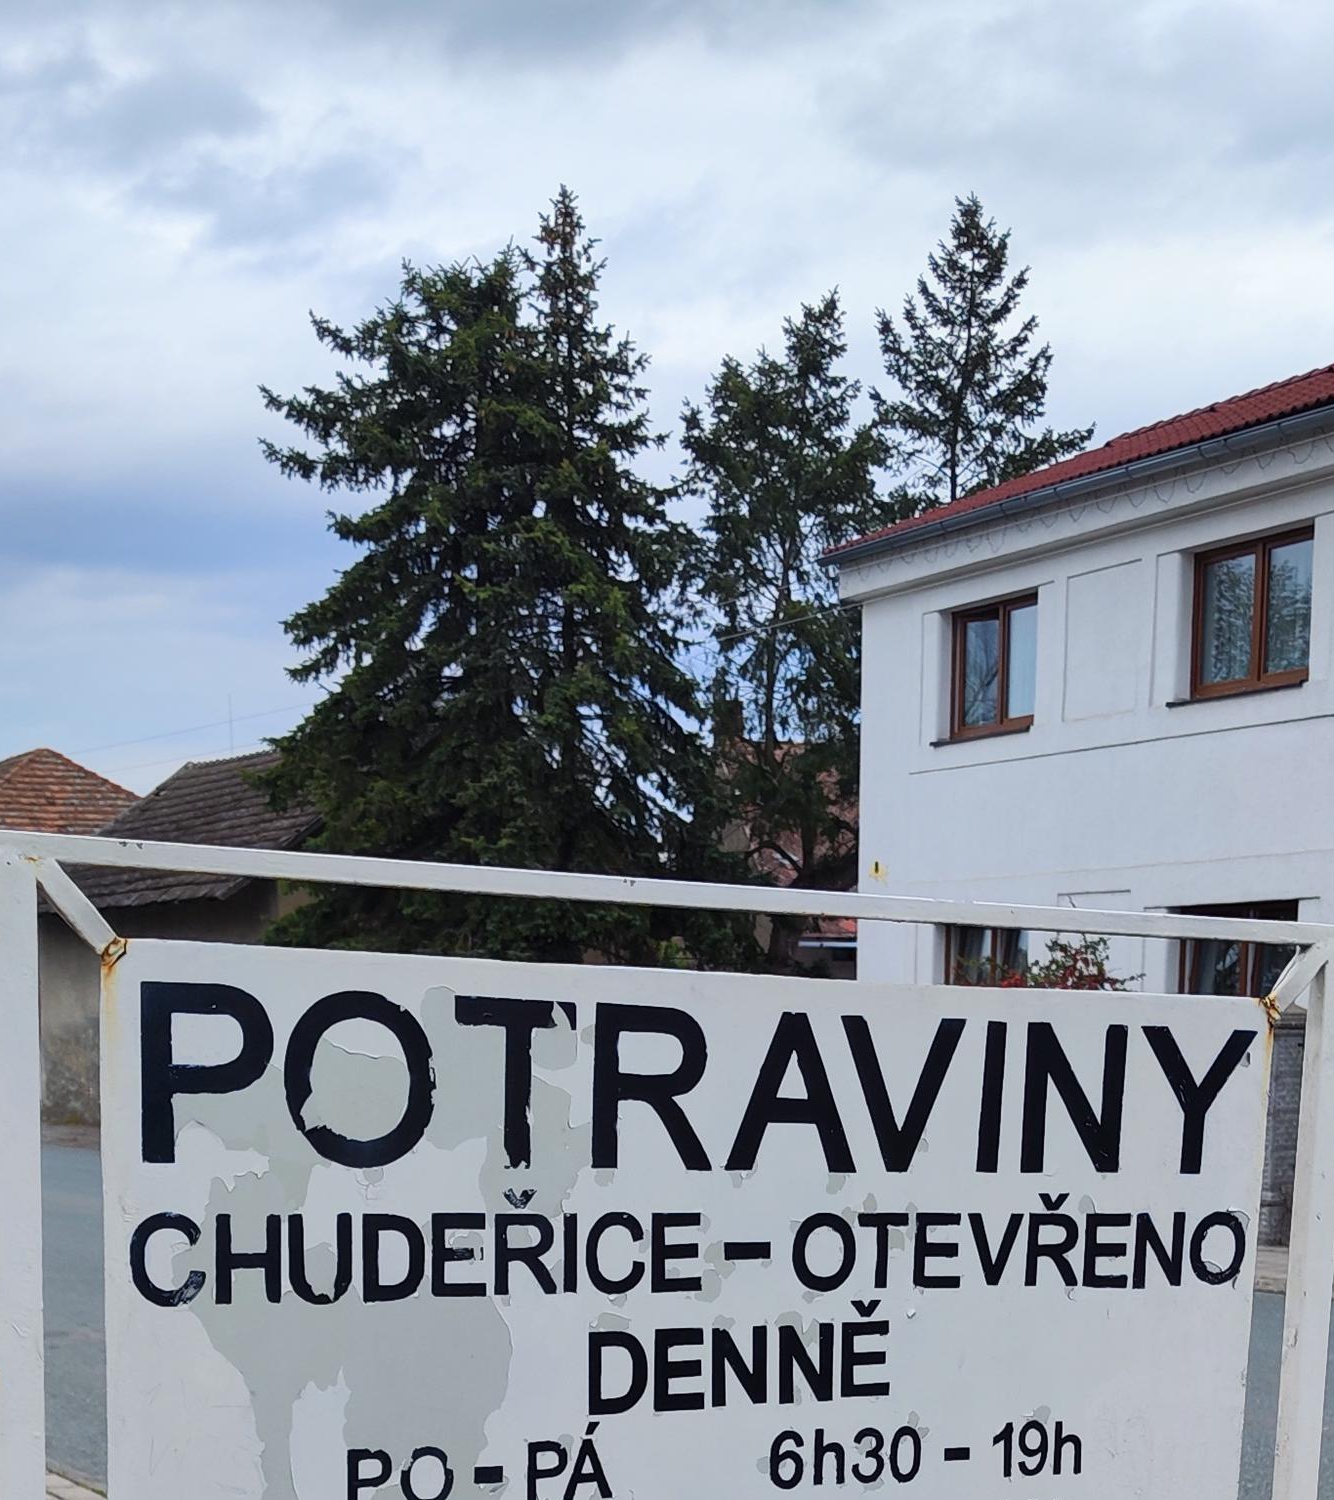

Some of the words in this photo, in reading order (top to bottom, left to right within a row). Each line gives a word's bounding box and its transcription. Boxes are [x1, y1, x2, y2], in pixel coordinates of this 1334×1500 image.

[141, 981, 1257, 1174] POTRAVINY
[588, 1300, 890, 1415] DENNĚ
[769, 1425, 922, 1490] 6h30
[992, 1419, 1082, 1478] 19h
